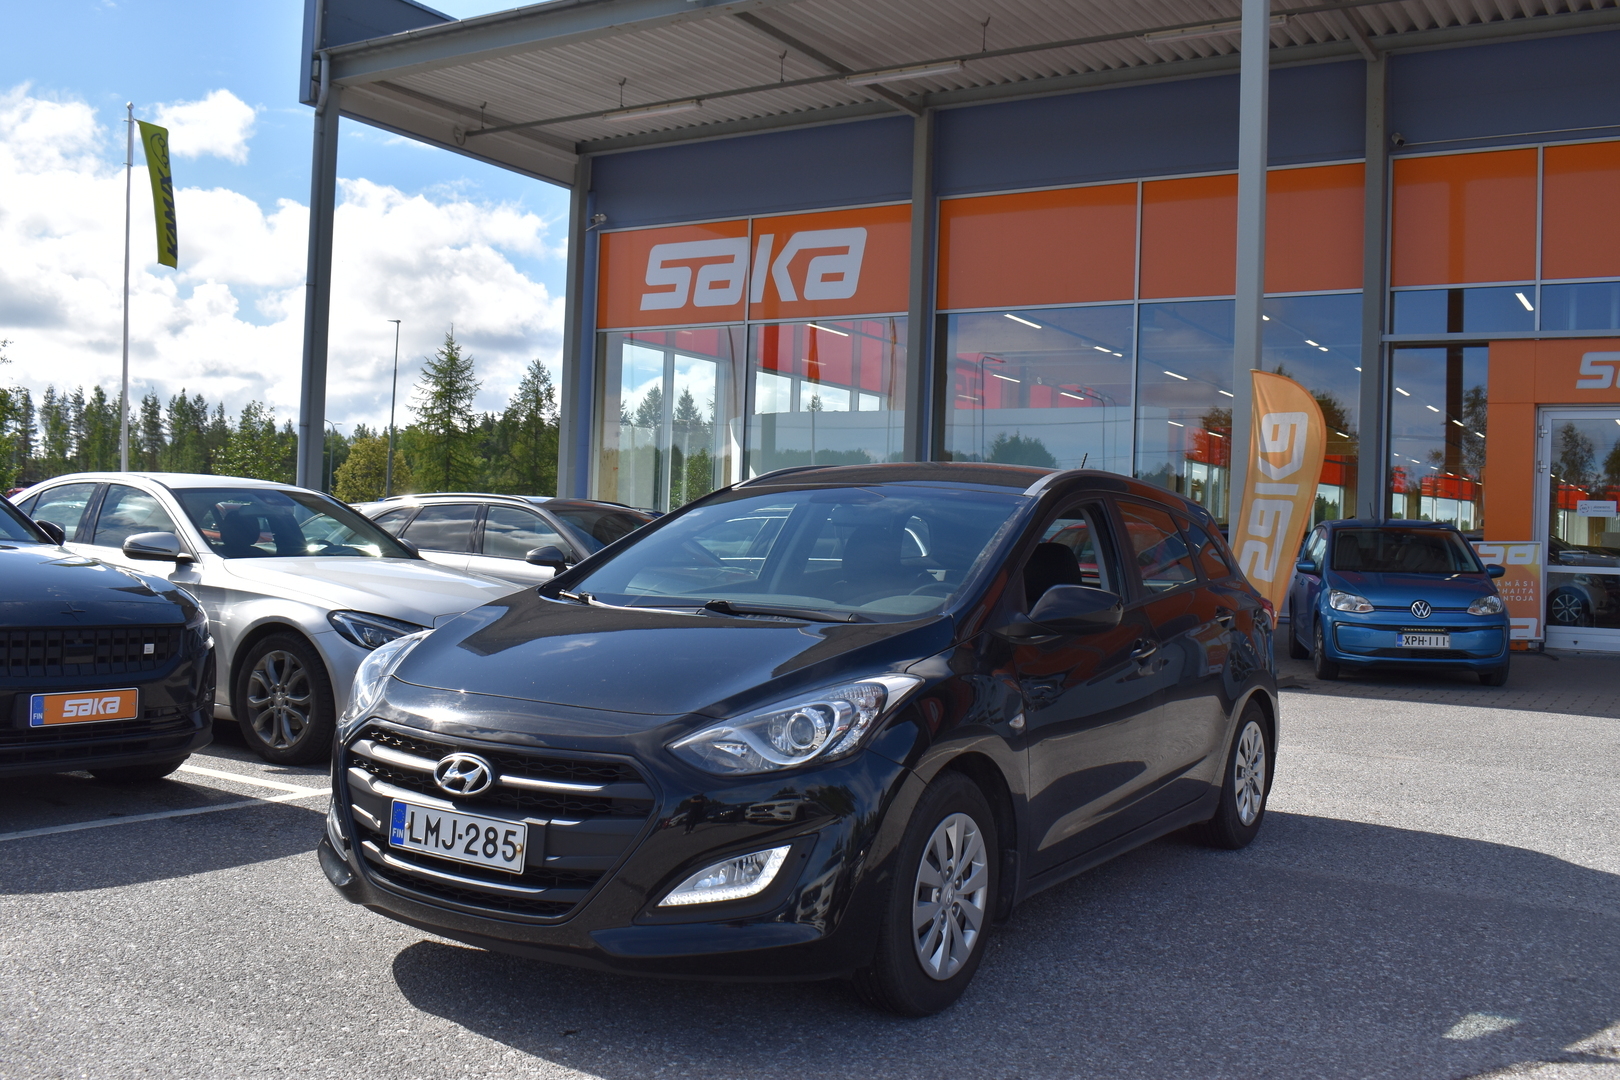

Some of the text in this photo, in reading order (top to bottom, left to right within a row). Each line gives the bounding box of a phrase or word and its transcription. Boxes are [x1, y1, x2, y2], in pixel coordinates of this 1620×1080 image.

[33, 712, 43, 720] FIN
[392, 827, 404, 839] FIN
[408, 811, 517, 862] LMJ-285
